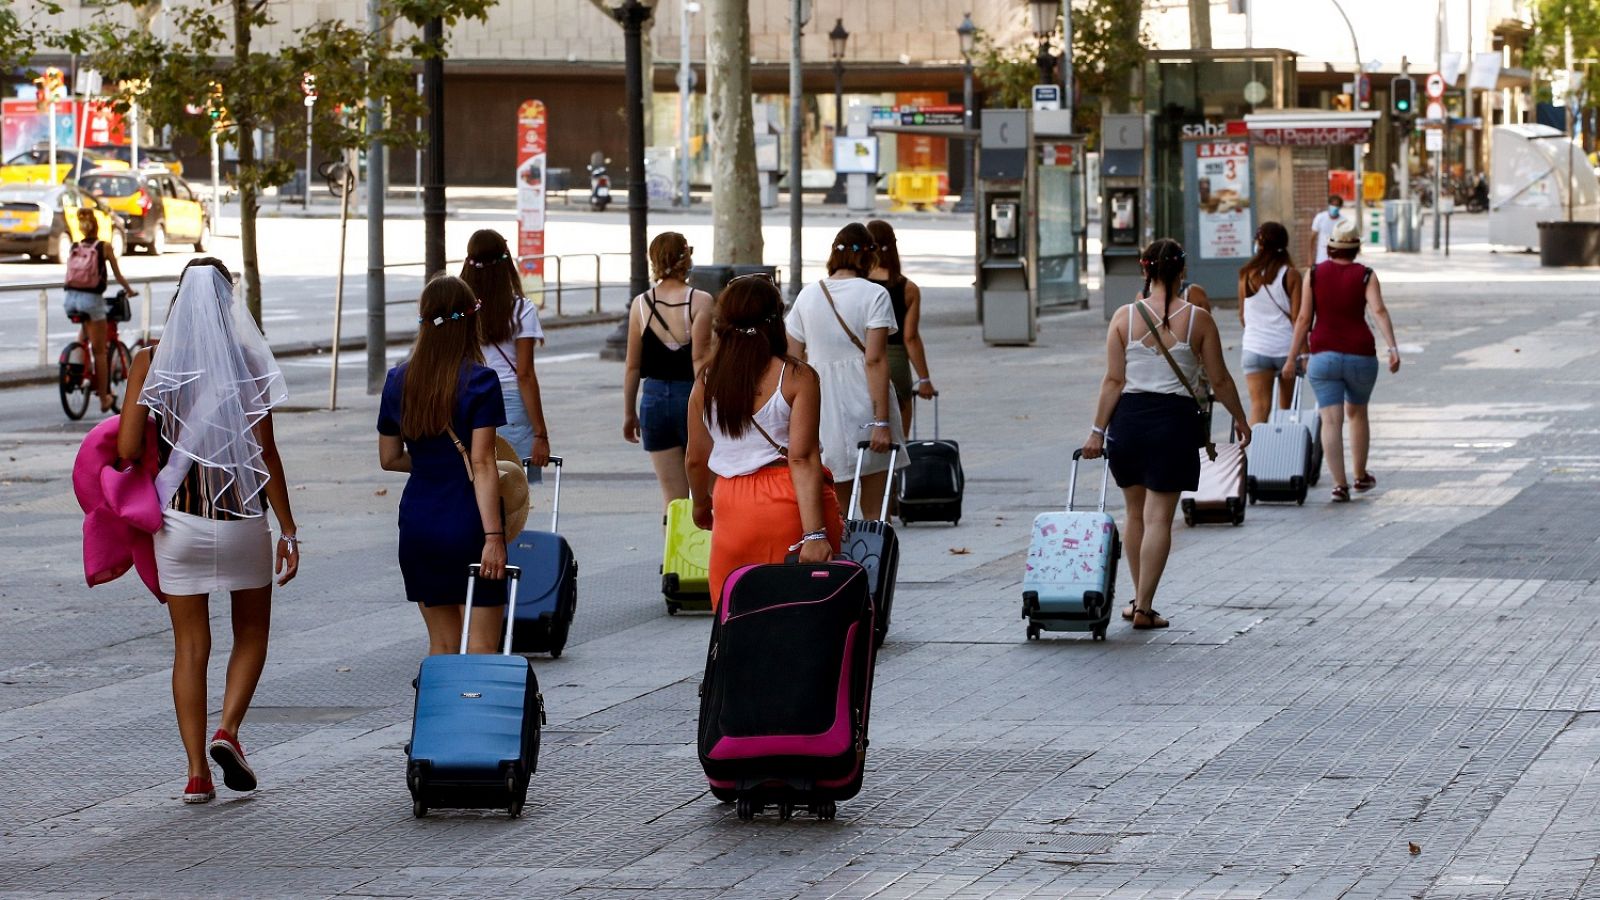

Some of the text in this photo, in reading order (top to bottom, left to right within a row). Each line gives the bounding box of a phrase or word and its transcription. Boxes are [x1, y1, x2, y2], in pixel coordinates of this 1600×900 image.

[1182, 119, 1226, 136] saba
[1266, 128, 1281, 144] el
[1214, 143, 1247, 155] KFC
